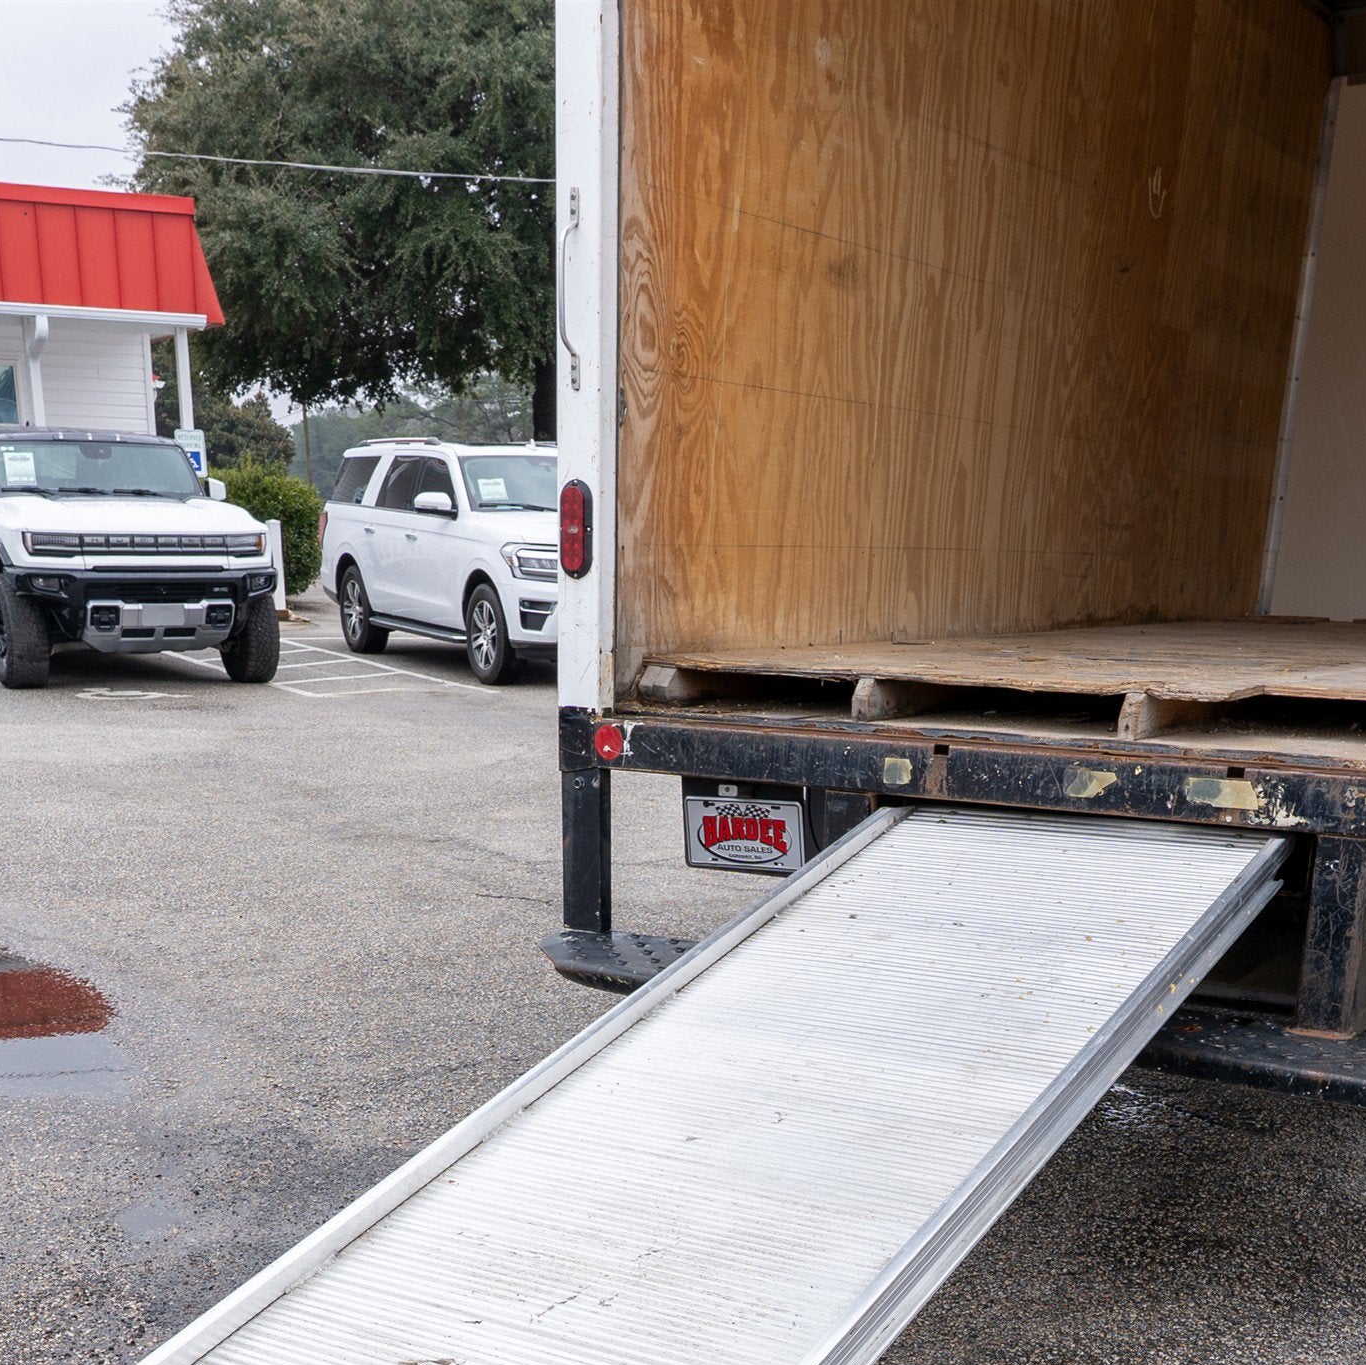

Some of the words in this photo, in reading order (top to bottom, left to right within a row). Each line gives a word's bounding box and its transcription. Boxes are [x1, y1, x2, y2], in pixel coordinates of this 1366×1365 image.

[703, 815, 788, 855] HARDEE
[717, 843, 742, 852] AUTO
[744, 845, 773, 854] SALES
